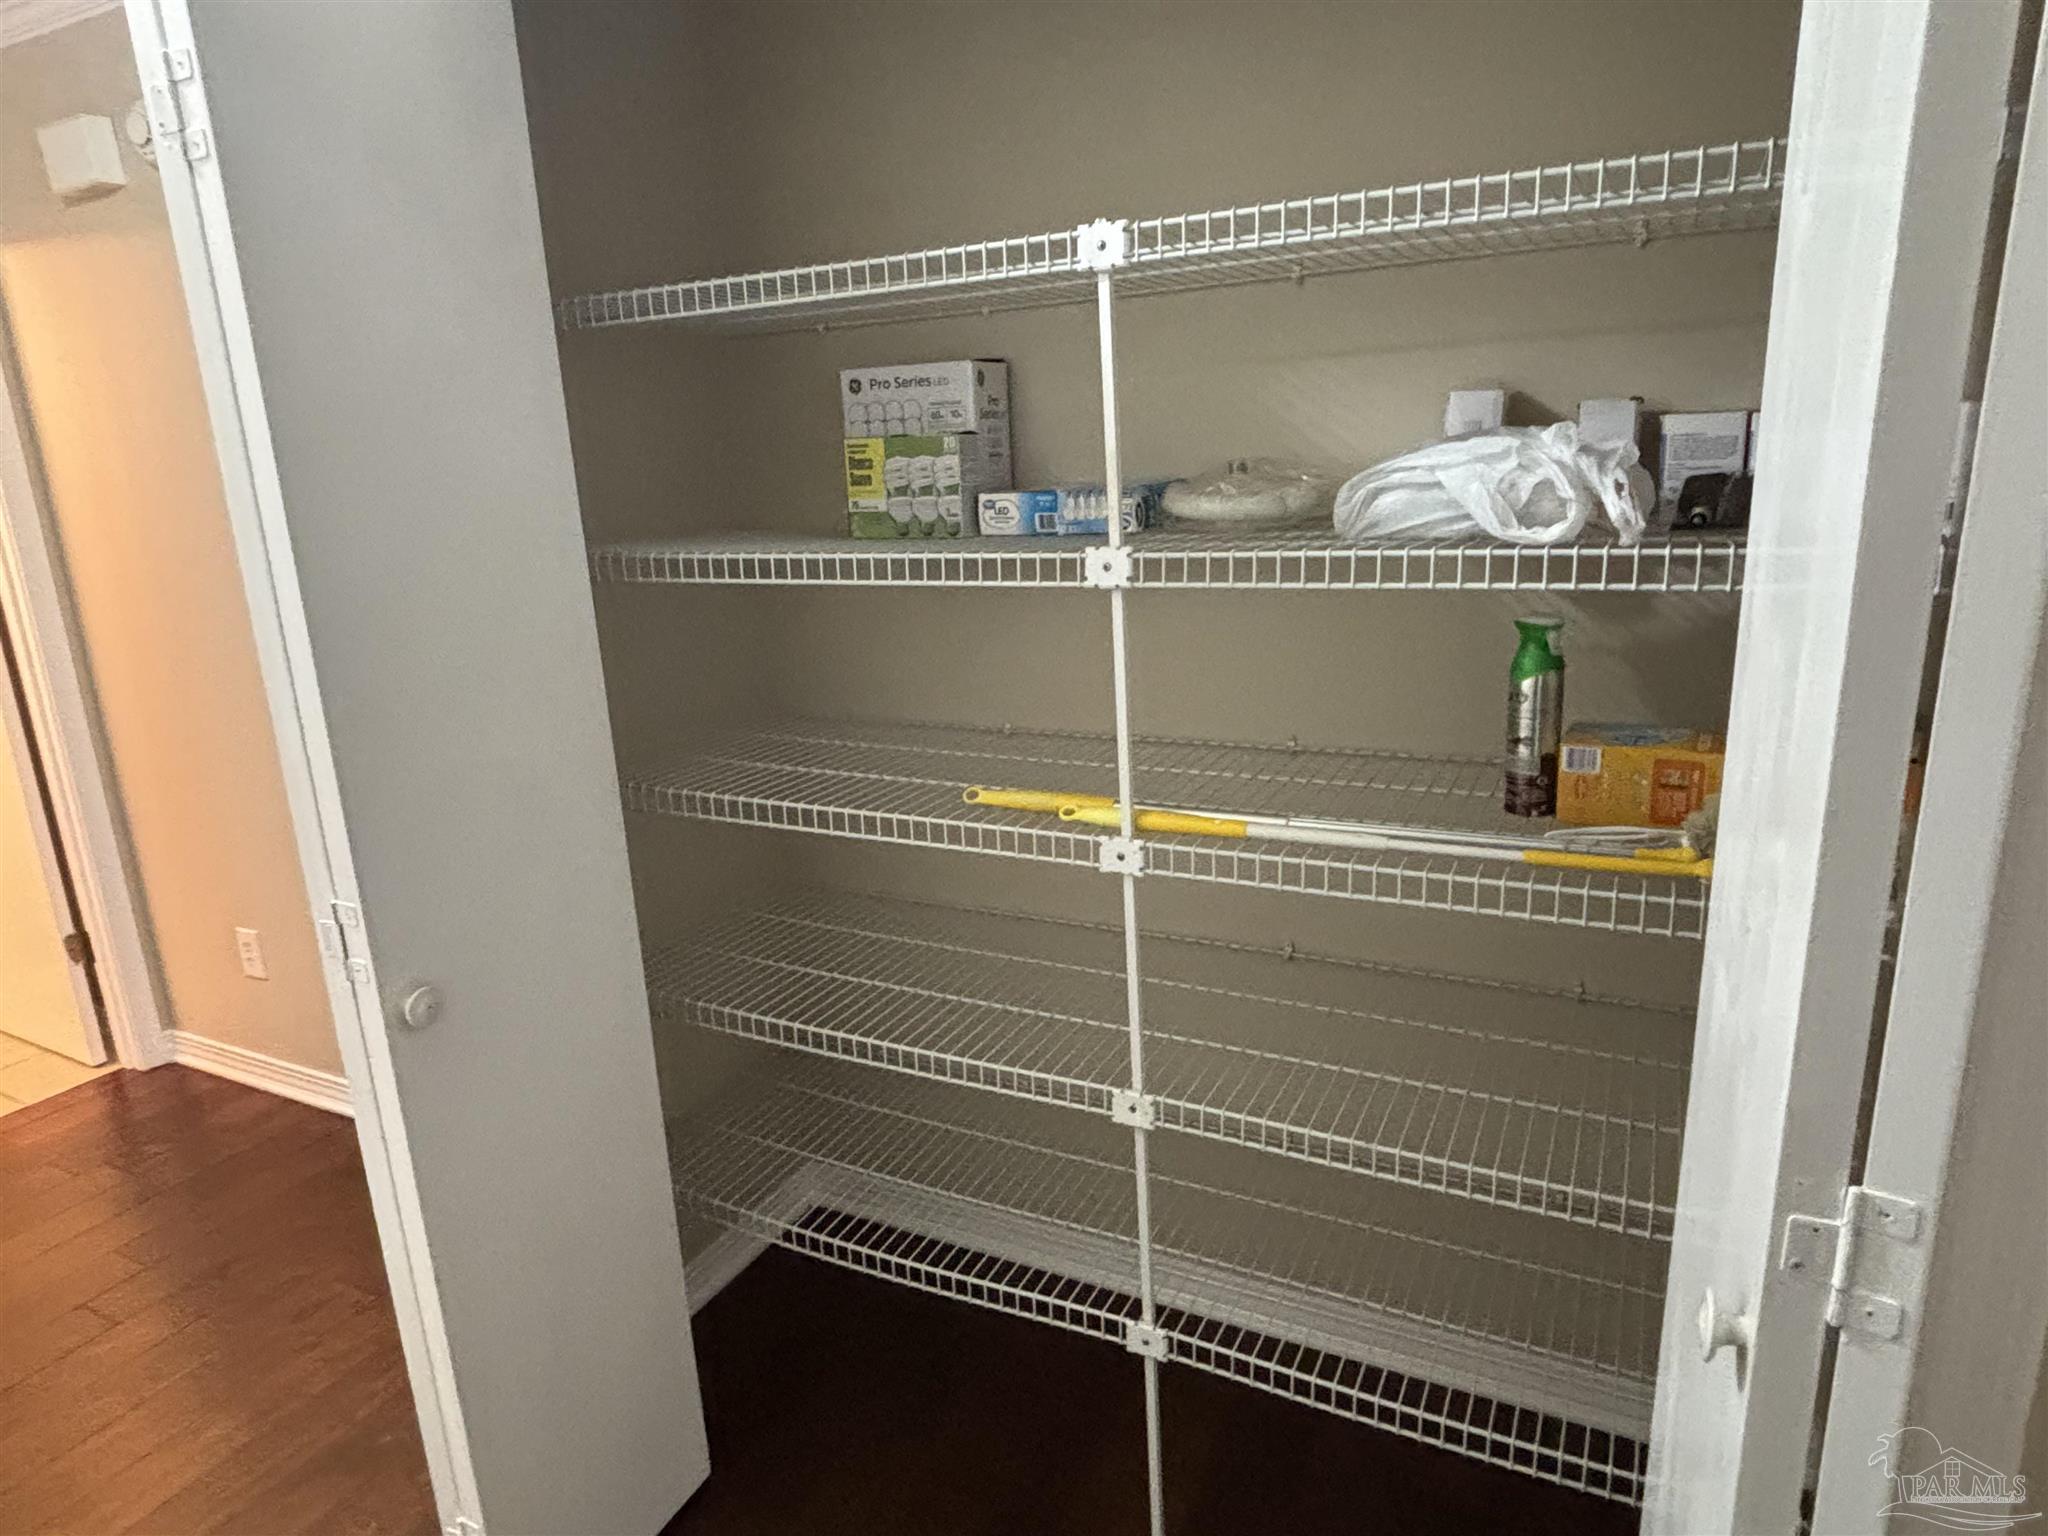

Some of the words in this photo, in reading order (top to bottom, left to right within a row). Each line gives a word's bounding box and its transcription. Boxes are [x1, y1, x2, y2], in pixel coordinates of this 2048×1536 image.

[869, 379, 891, 390] Pro
[894, 376, 932, 389] Series
[933, 377, 950, 386] LED
[943, 436, 956, 449] 20
[994, 506, 1010, 516] LED
